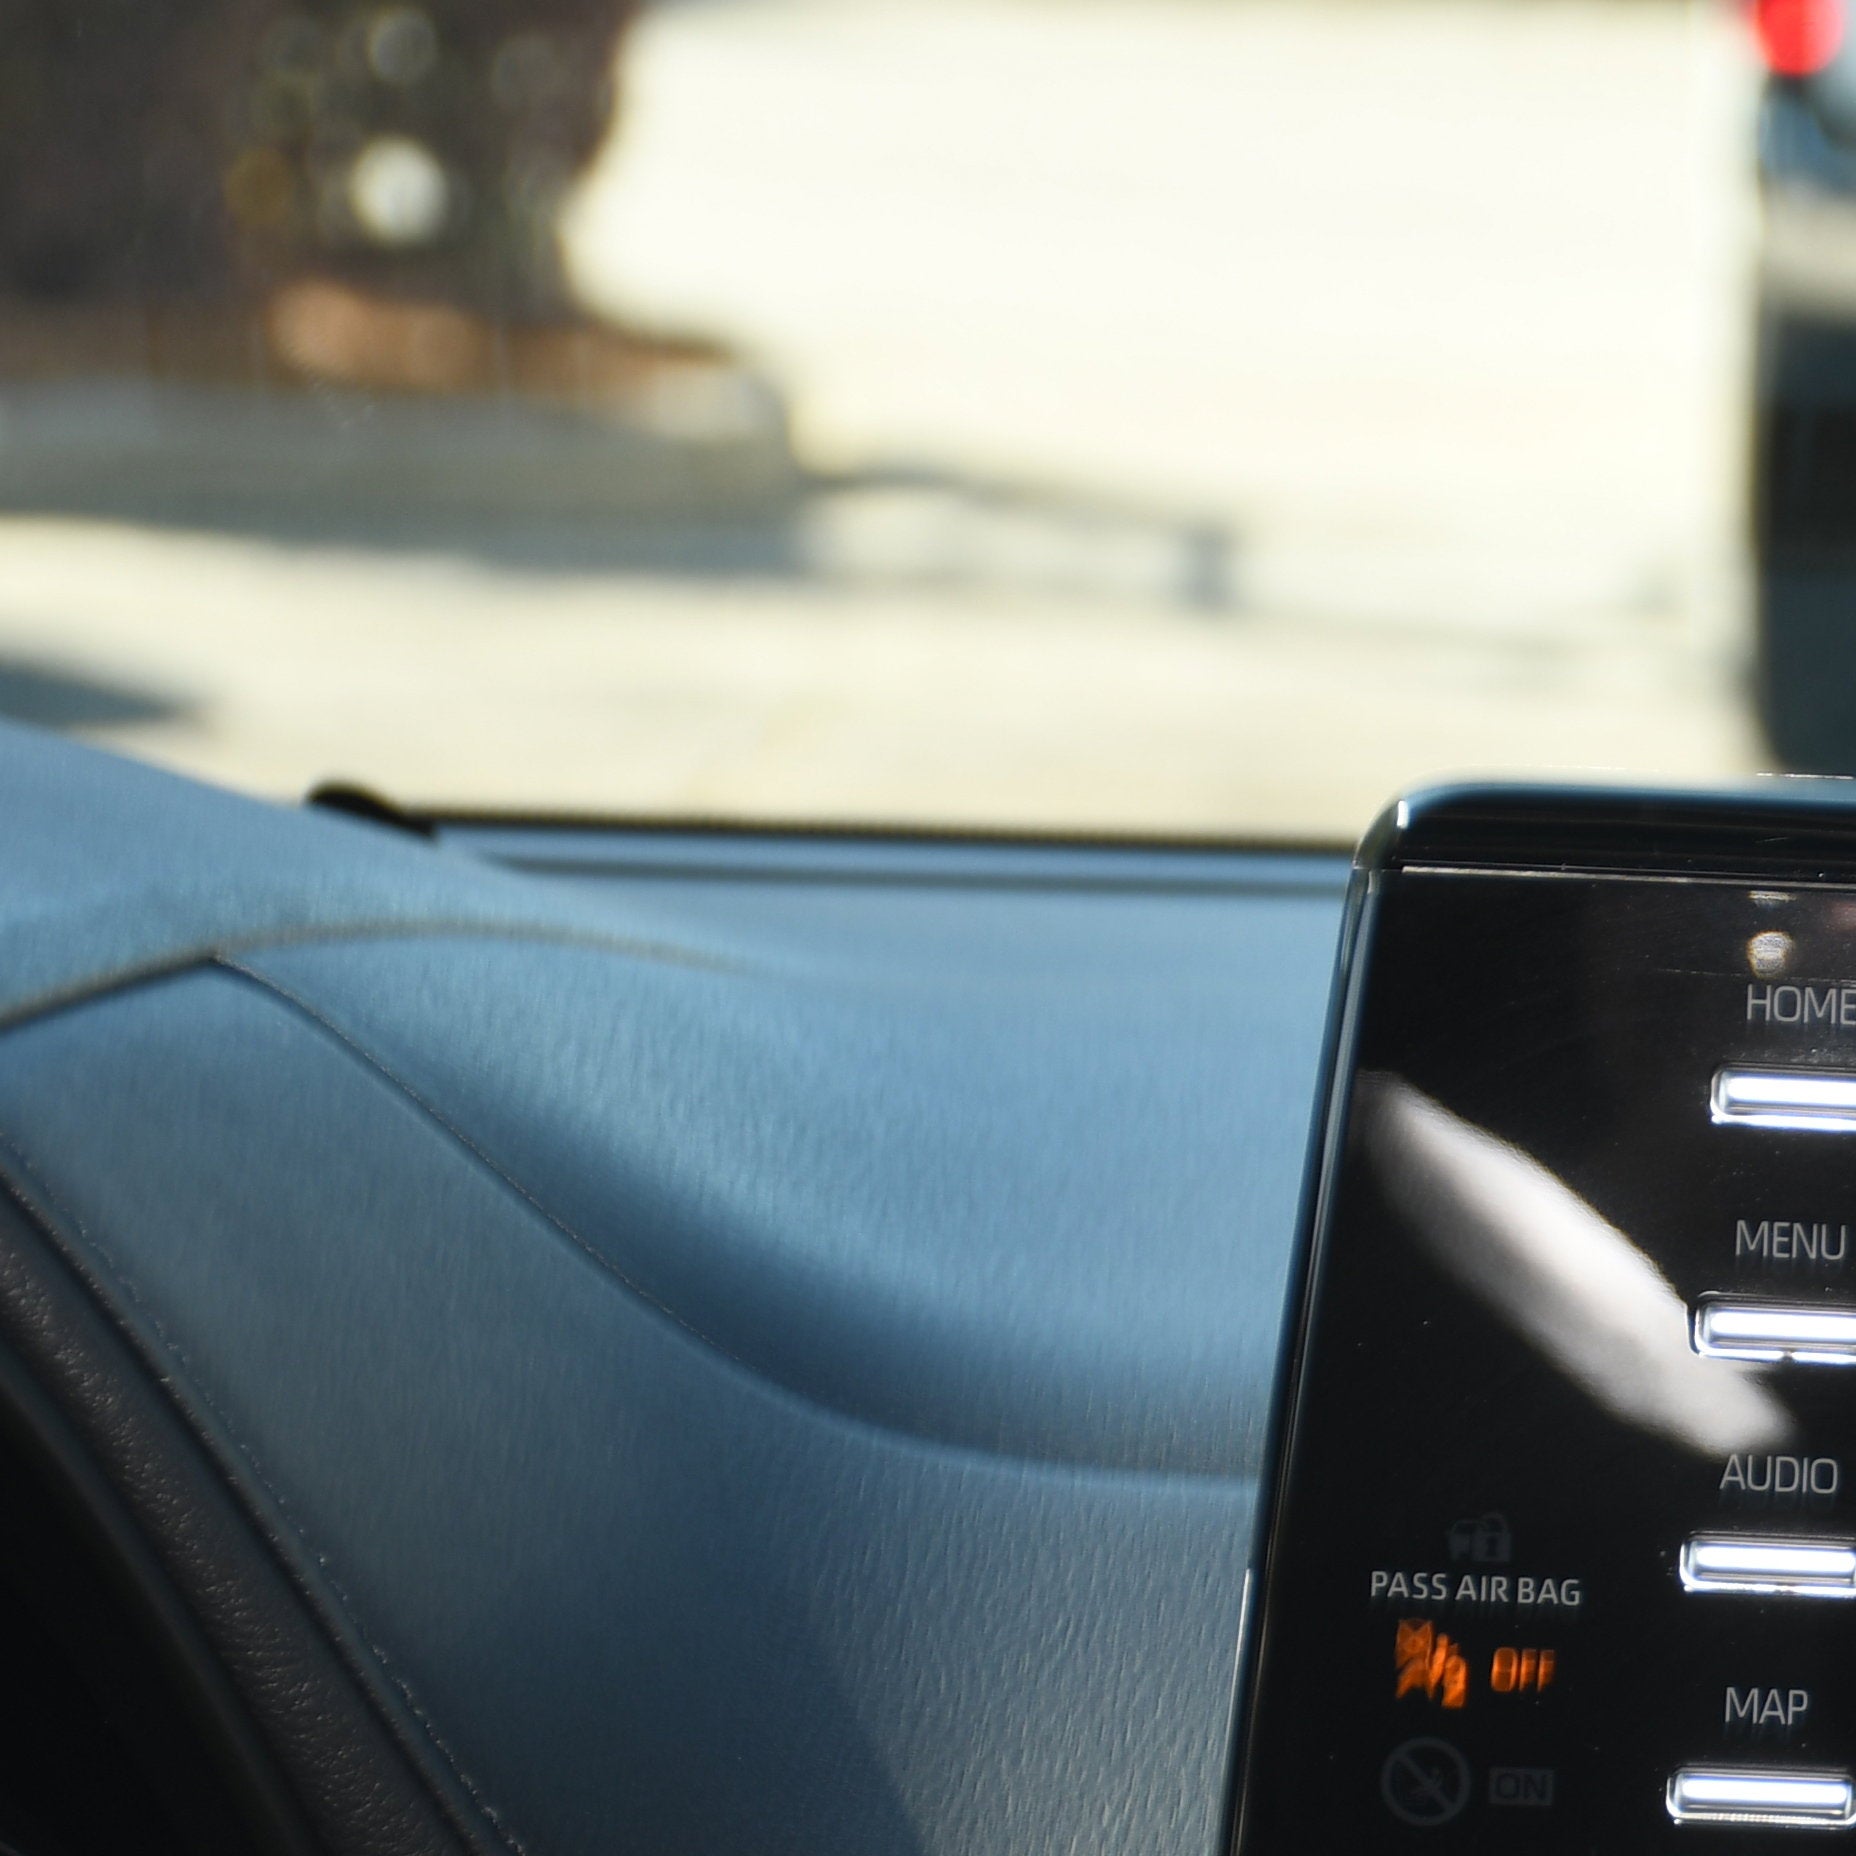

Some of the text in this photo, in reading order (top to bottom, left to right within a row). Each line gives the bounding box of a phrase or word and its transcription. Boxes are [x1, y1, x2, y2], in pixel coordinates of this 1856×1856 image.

[1735, 1219, 1847, 1261] MENU
[1719, 1453, 1840, 1495] AUDIO
[1369, 1570, 1582, 1607] PASS AIR BAG
[1490, 1646, 1556, 1693] OFF
[1724, 1686, 1809, 1726] MAP
